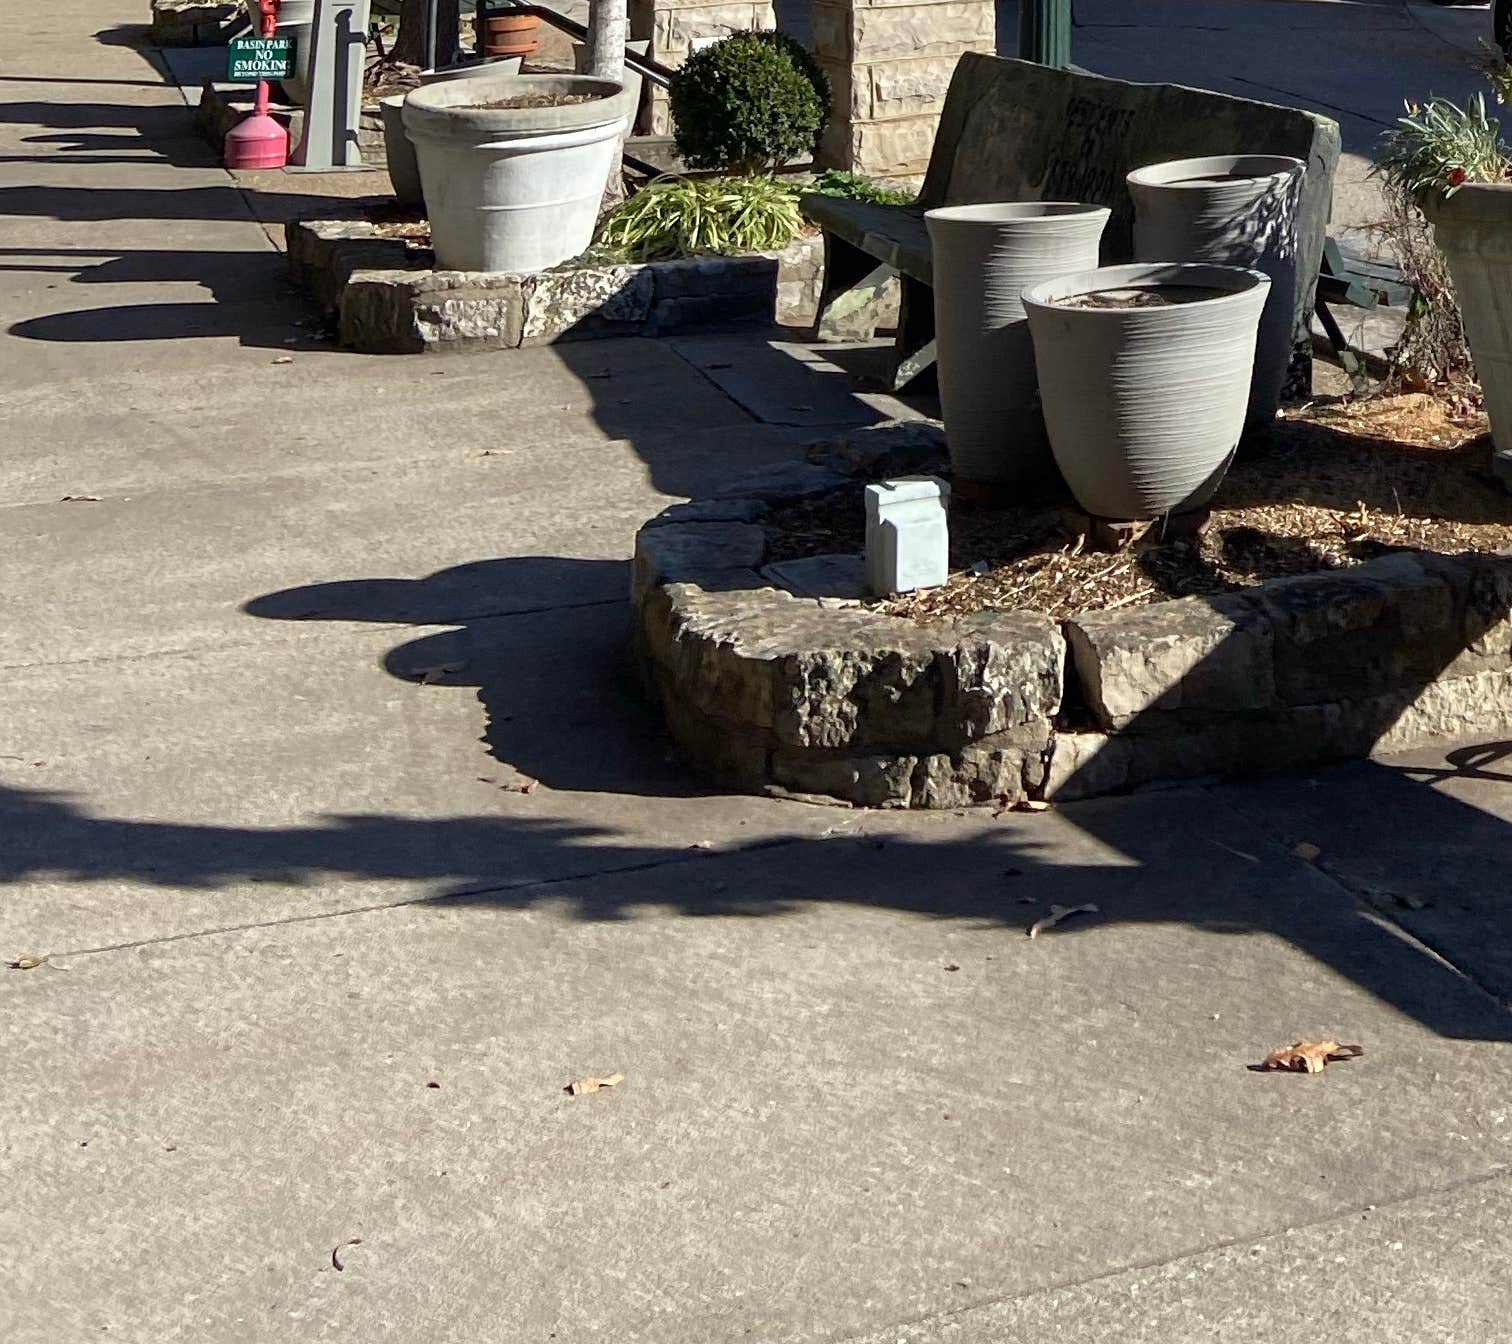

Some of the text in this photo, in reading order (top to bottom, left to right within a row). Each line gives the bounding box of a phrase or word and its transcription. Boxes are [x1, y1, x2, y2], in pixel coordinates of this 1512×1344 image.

[237, 39, 292, 50] BASIN PARK
[255, 50, 274, 61] NO
[234, 60, 290, 72] SMOKING
